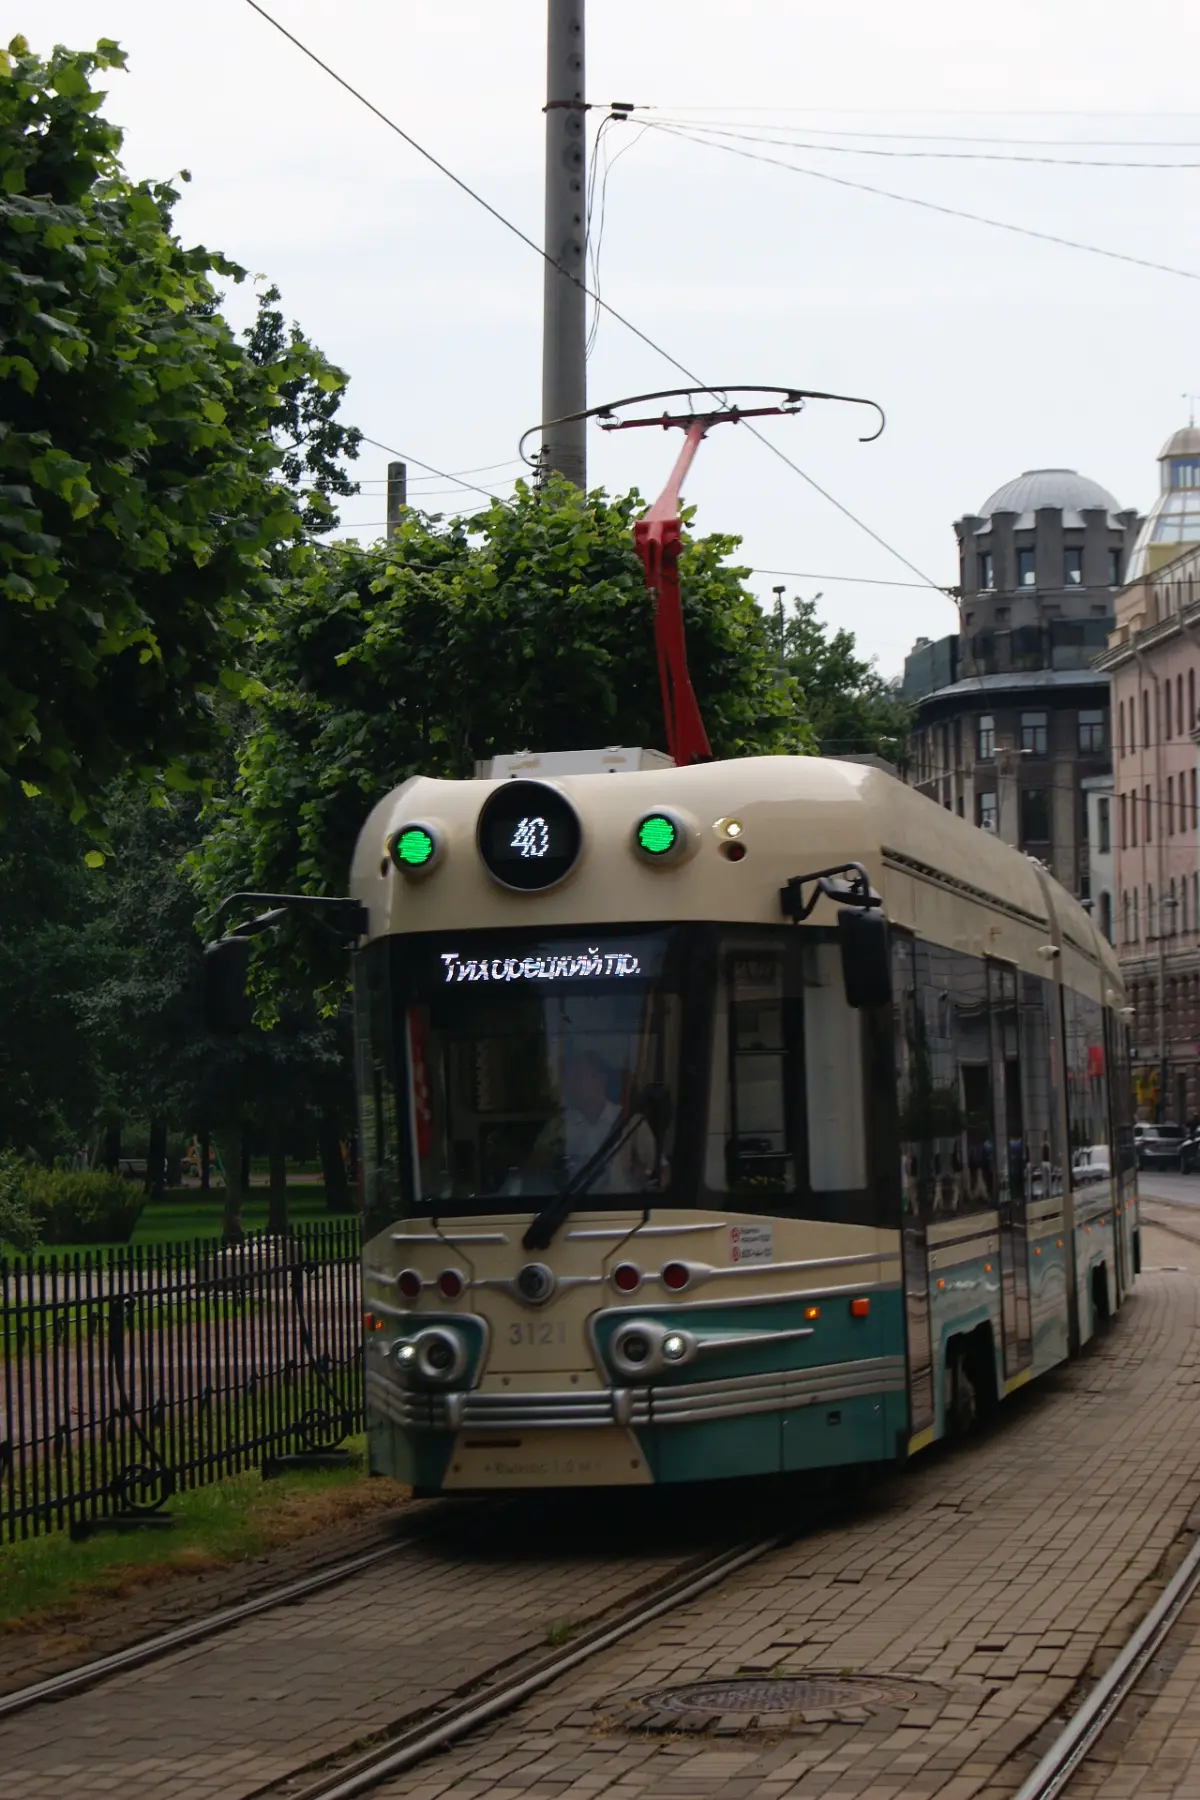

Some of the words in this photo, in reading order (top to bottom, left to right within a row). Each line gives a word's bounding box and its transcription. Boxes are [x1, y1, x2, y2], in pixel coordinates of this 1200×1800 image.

[511, 817, 549, 857] 40
[440, 947, 602, 982] Тихорецкий
[604, 953, 641, 977] пр.
[507, 1321, 567, 1346] 3121
